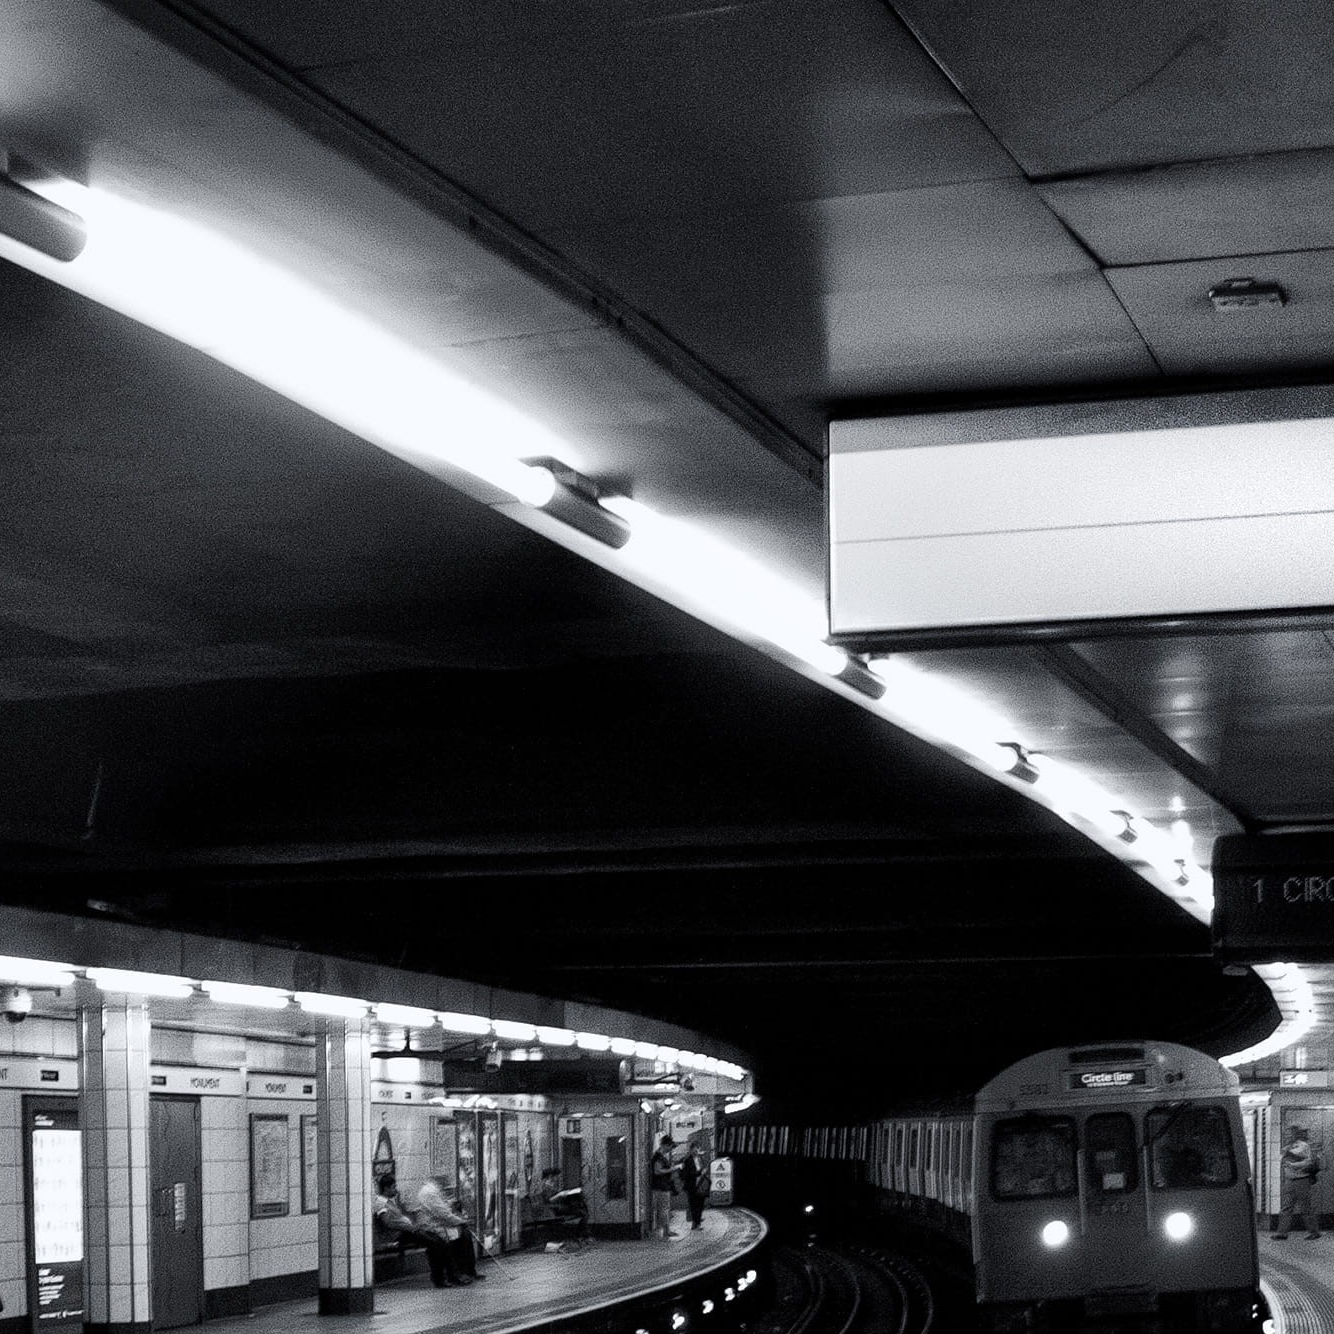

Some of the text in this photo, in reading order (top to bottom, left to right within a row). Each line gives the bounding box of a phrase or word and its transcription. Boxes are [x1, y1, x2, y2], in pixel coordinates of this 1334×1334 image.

[1253, 879, 1264, 903] 1
[1081, 1072, 1135, 1083] Circle line
